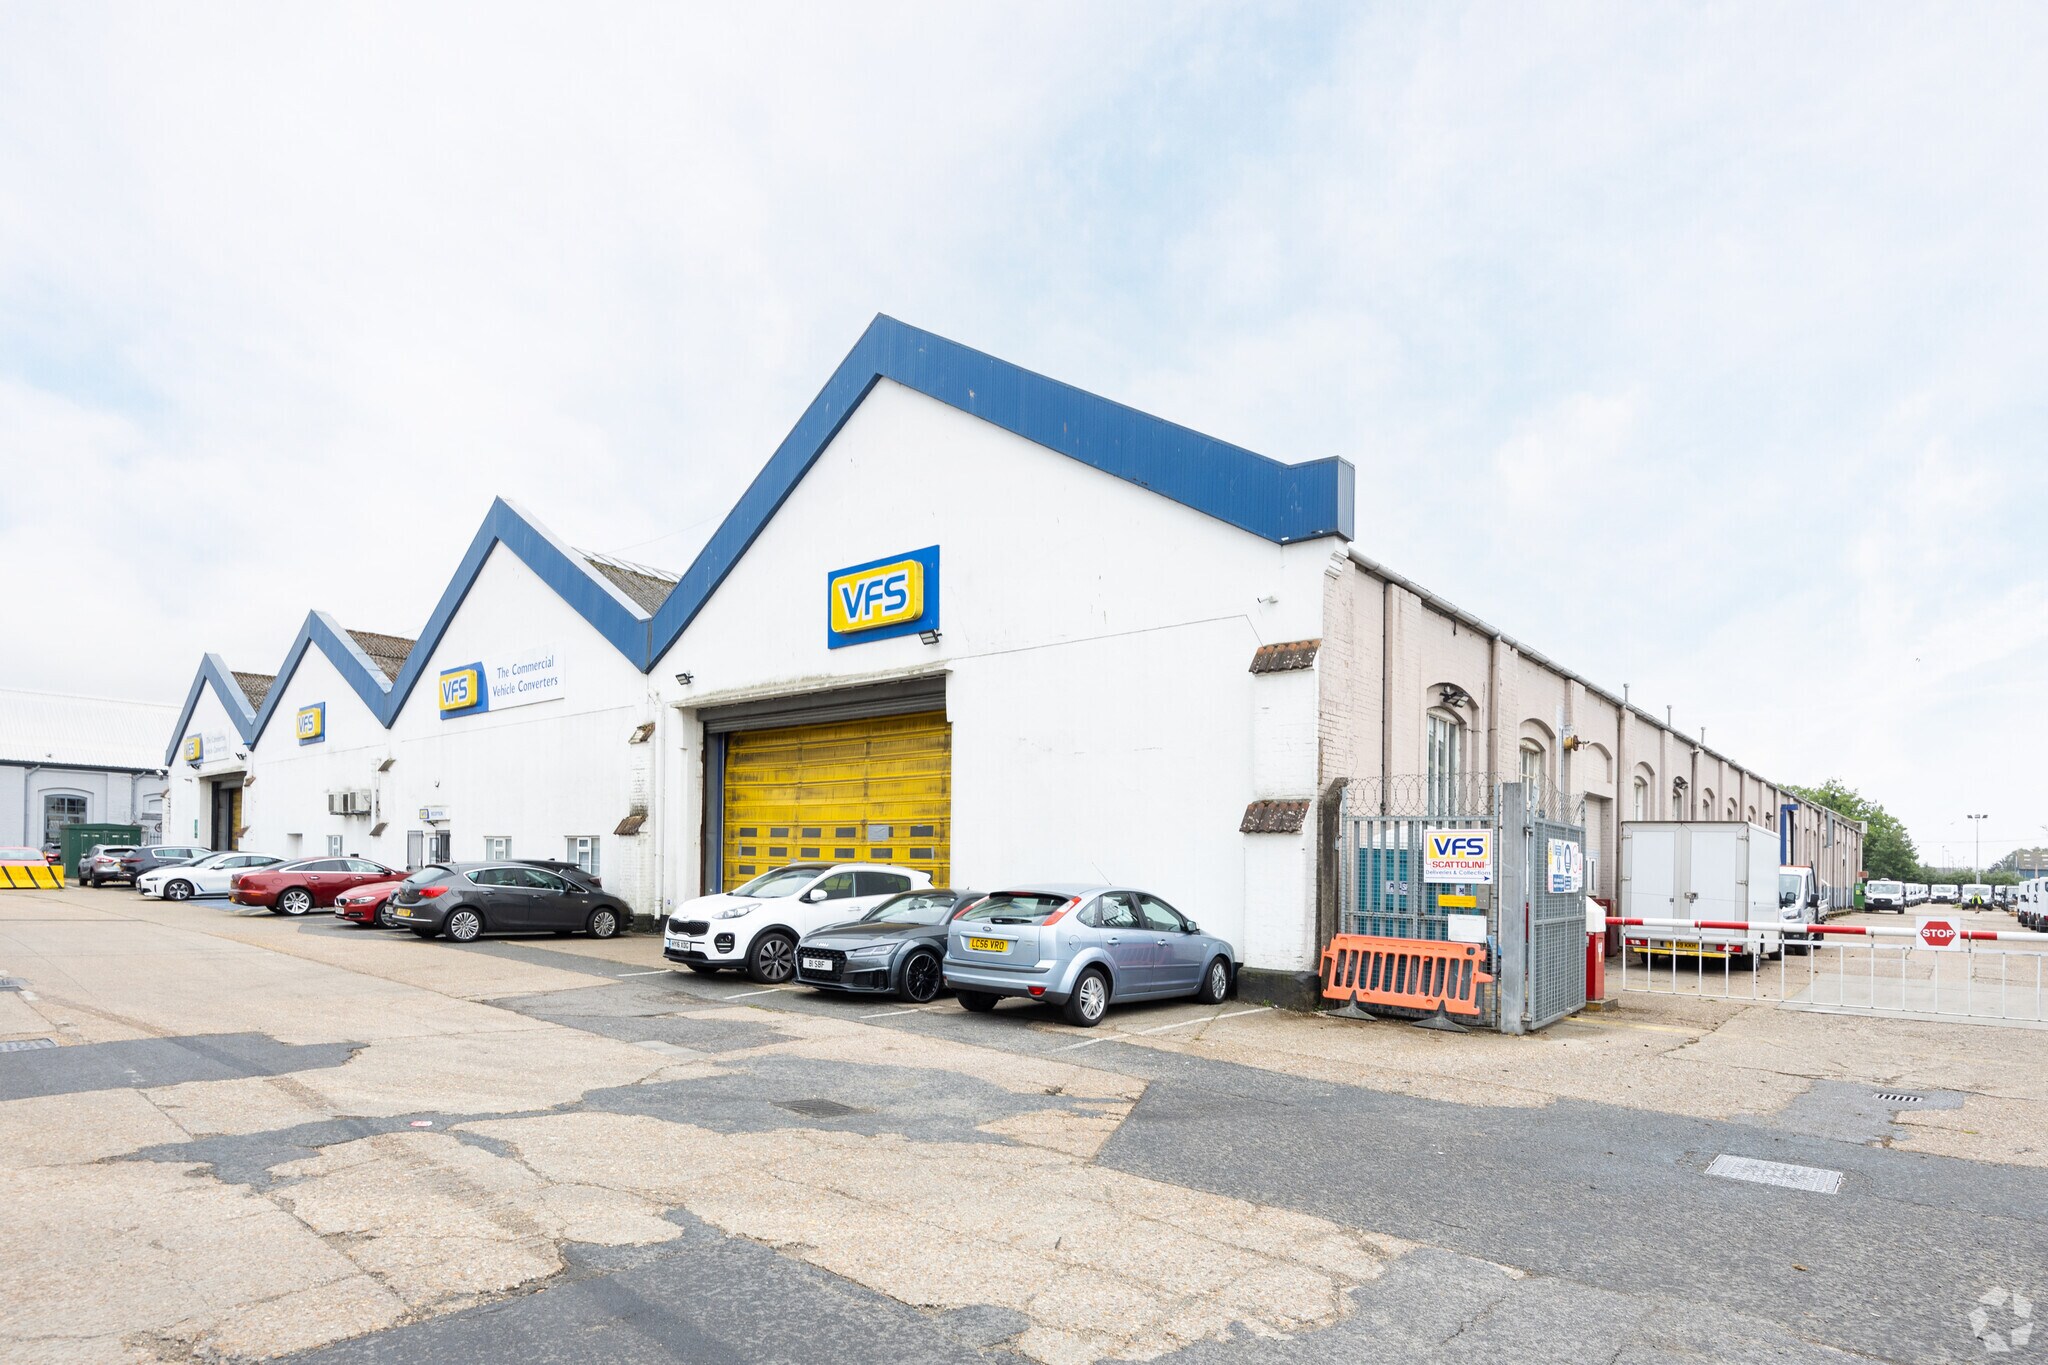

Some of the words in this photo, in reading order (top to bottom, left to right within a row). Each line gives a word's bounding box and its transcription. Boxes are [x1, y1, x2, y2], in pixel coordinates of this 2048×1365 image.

[841, 573, 907, 619] VFS
[497, 667, 510, 679] The
[512, 655, 554, 676] Commercial
[442, 677, 468, 703] VFS
[493, 682, 515, 697] Vehicle
[518, 677, 558, 692] Converters
[298, 714, 314, 734] VFS
[1434, 838, 1484, 856] VFS
[1432, 861, 1485, 869] SCATTOLINI
[1922, 929, 1955, 938] STOP
[971, 939, 989, 949] LC56
[990, 940, 1005, 950] VRO
